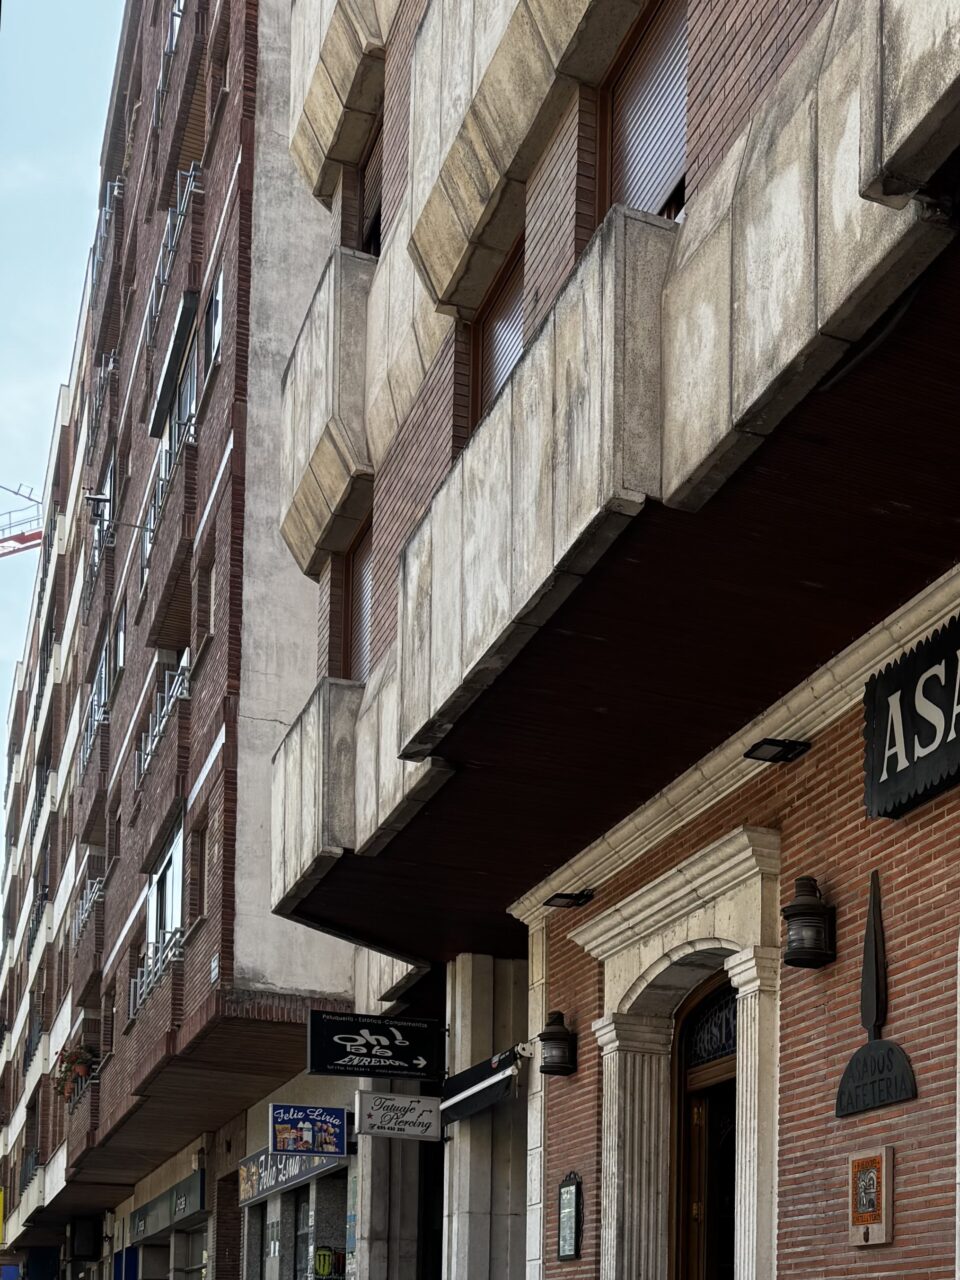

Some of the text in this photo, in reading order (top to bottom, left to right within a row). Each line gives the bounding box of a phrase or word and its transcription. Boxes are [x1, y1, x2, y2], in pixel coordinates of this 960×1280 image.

[333, 1054, 409, 1067] ENREDOS
[273, 1107, 342, 1125] Feliz Liria
[371, 1096, 416, 1118] Tatuaje
[380, 1111, 432, 1135] Piercing
